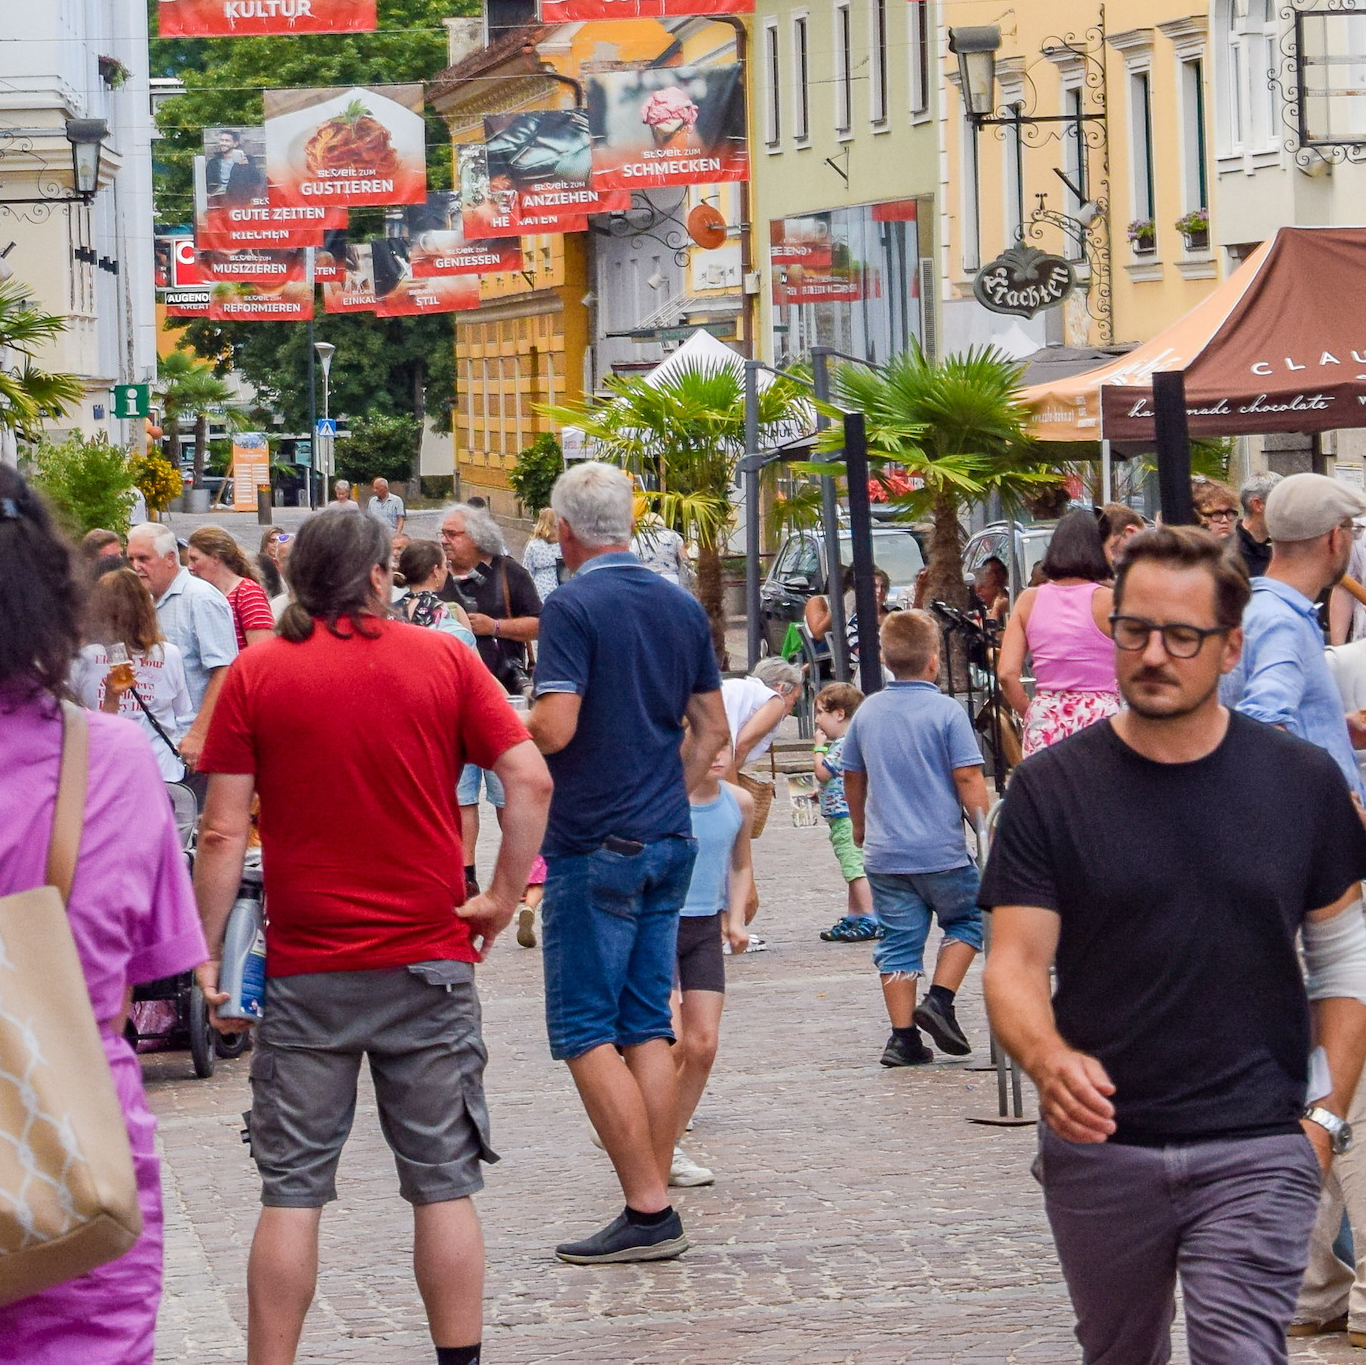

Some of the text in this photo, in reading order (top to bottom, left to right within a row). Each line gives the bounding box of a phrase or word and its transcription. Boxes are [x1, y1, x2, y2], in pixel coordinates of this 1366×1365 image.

[224, 0, 312, 19] KULTUR
[684, 148, 701, 156] ZUM
[622, 158, 721, 178] SCHMECKEN
[301, 179, 394, 196] GUSTIEREN
[524, 190, 599, 208] ANZIEHEN
[230, 207, 325, 221] GUTE ZEITEN
[213, 263, 287, 275] MUSIZIEREN
[435, 254, 501, 269] GENIESSEN
[982, 265, 1070, 308] Trachten
[223, 303, 301, 313] REFORMIEREN
[416, 296, 440, 307] STIL
[1238, 394, 1336, 415] chocolate
